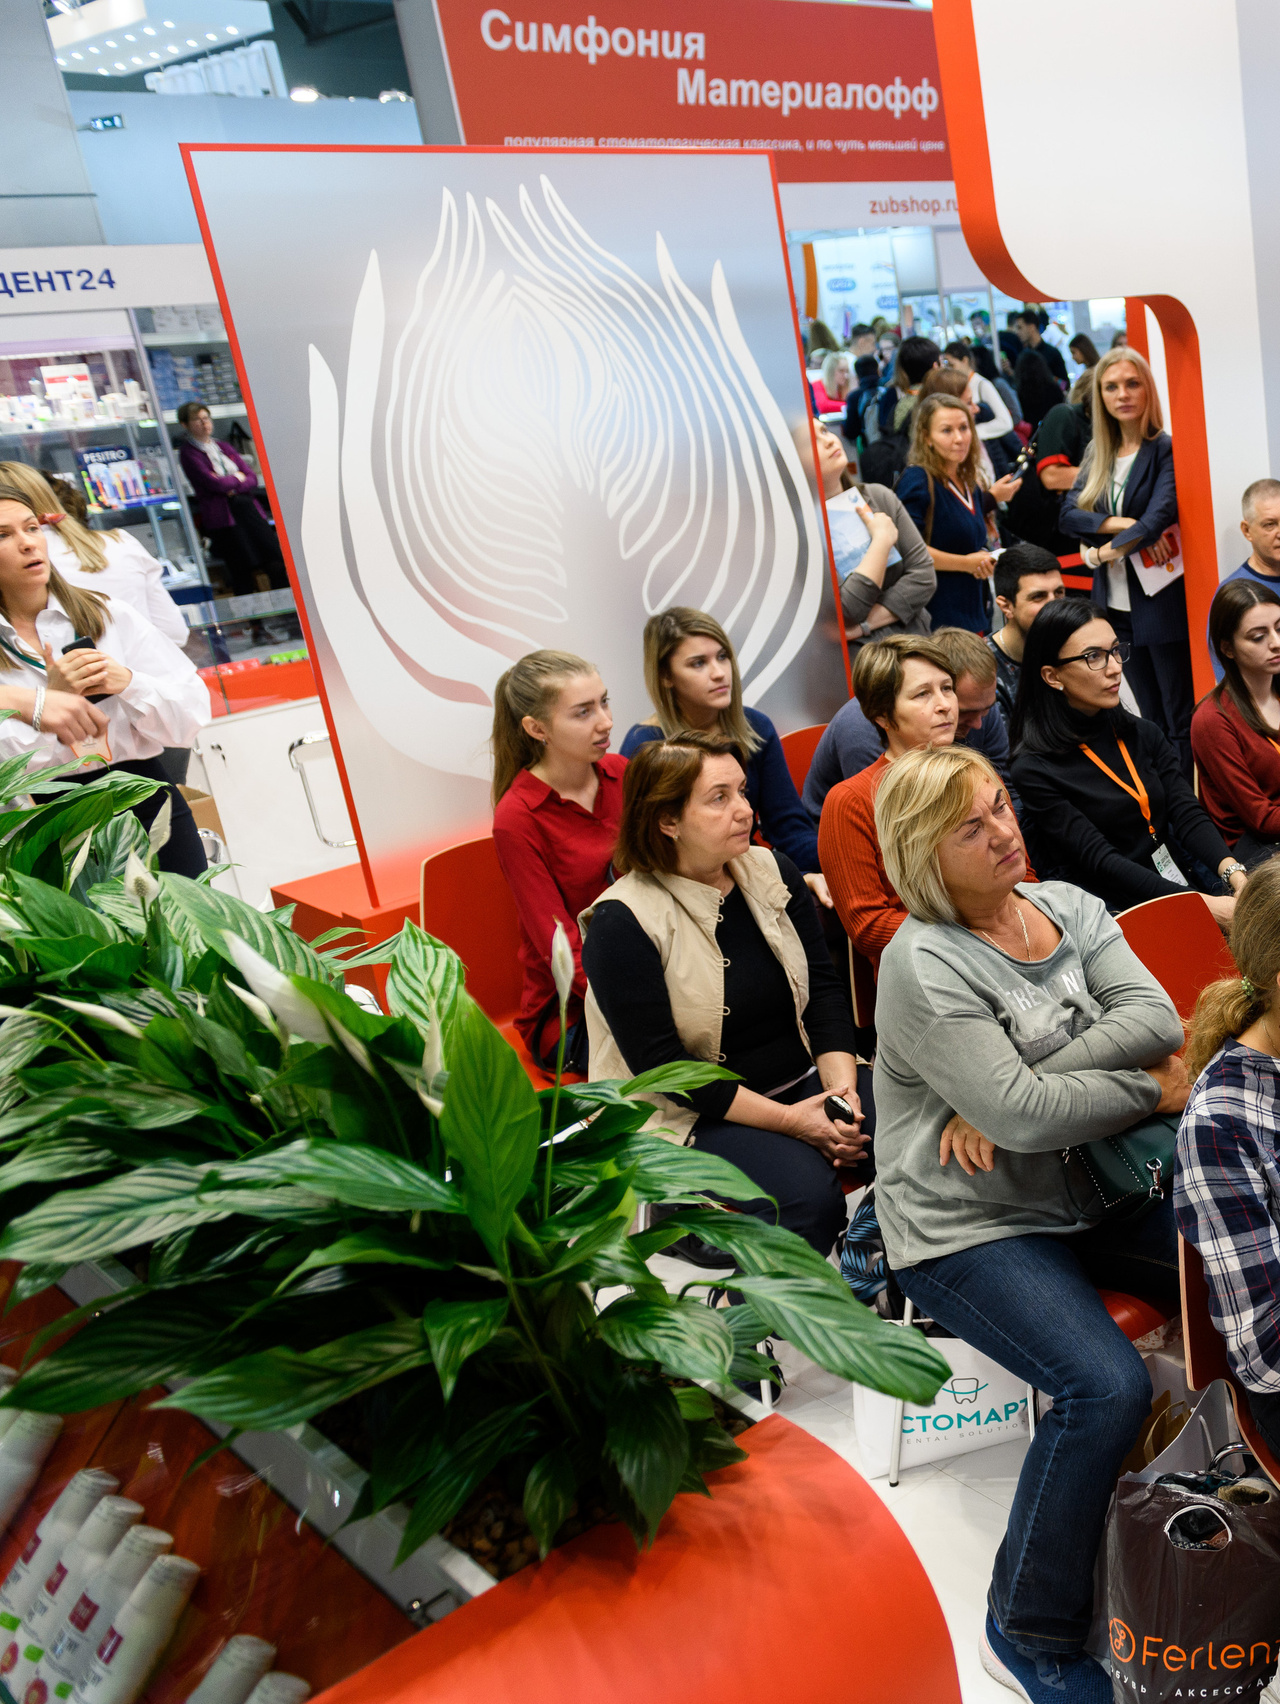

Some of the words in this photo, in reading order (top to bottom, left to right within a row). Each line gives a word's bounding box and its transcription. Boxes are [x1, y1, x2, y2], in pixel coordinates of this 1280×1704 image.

[480, 8, 706, 65] Симфония
[676, 67, 940, 120] Материалофф
[869, 195, 959, 217] zubshop.ru
[902, 1435, 949, 1445] ENTAL
[959, 1418, 1027, 1438] SOLUTION
[1110, 1664, 1147, 1694] БУВЬ
[1174, 1675, 1278, 1698] АКСЕССАР
